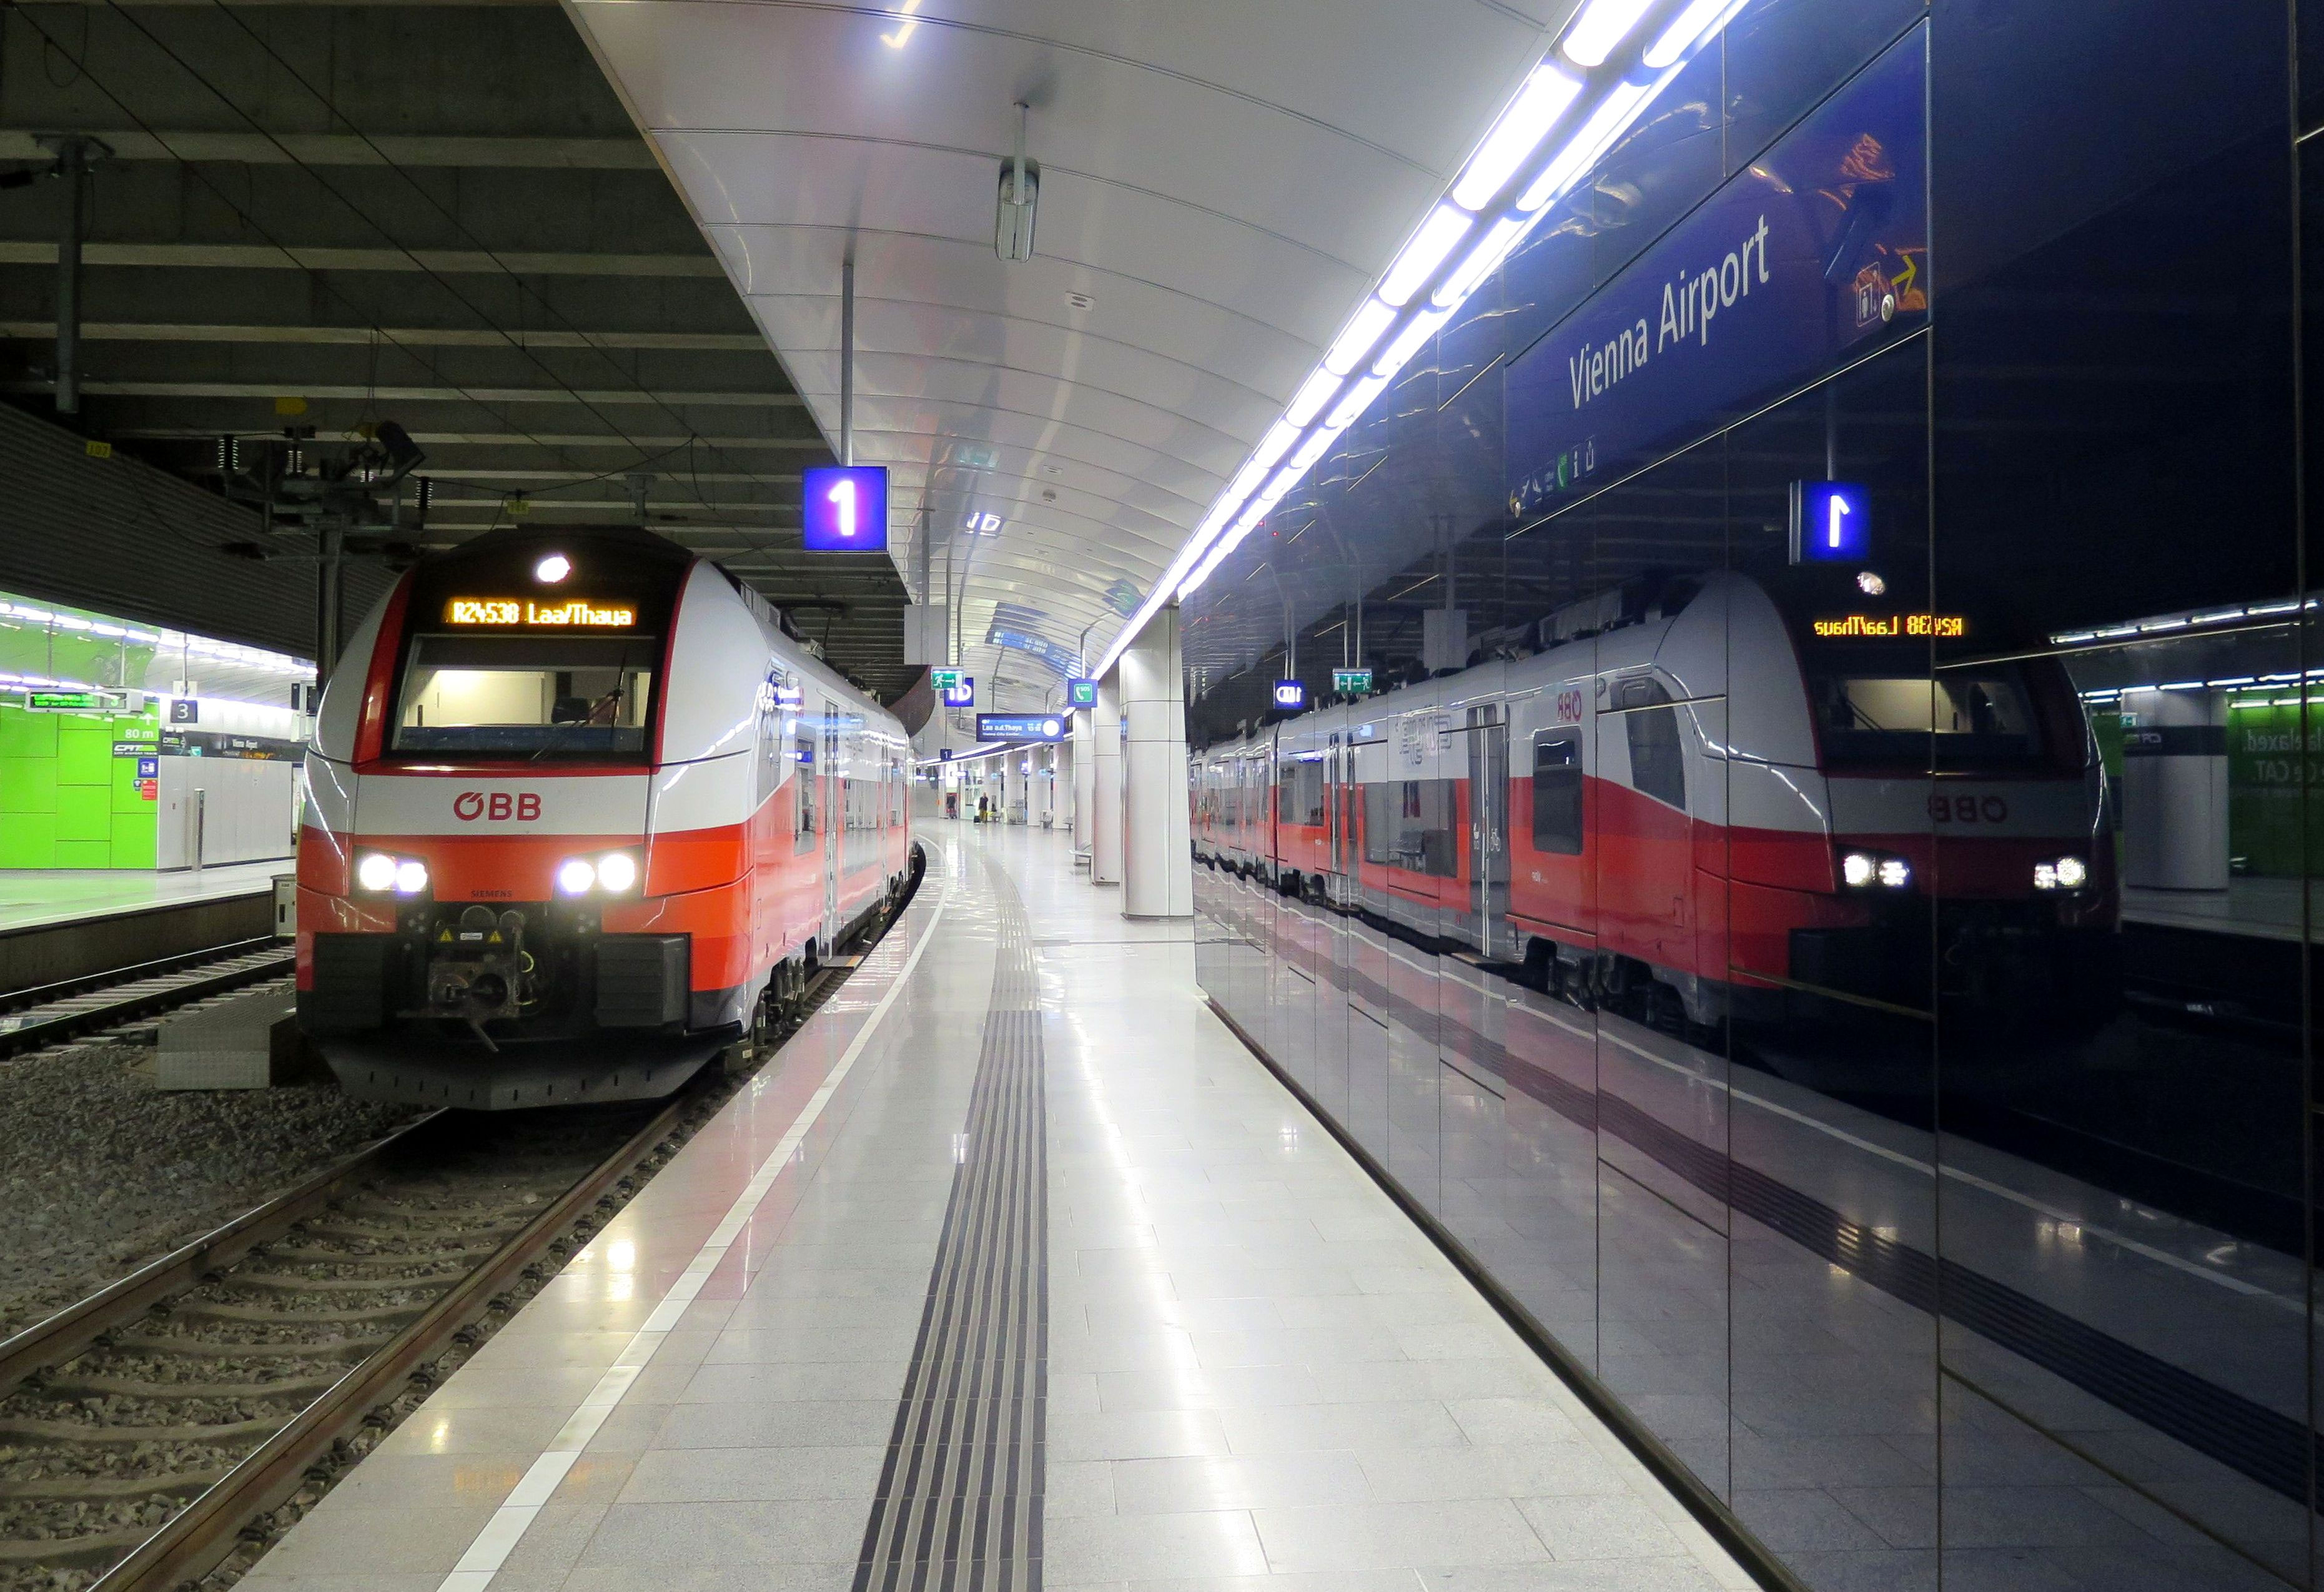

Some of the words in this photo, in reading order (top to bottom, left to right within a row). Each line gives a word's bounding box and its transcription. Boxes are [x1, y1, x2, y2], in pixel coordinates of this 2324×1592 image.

[1569, 318, 1648, 409] Vienna
[1658, 214, 1769, 354] Airport
[828, 480, 855, 536] 1
[453, 601, 520, 624] R24538
[528, 603, 632, 626] Laa/Thaya
[177, 703, 189, 719] 3
[125, 728, 140, 739] 80
[142, 730, 154, 739] m
[944, 751, 949, 759] 1
[453, 791, 541, 821] ÖBB
[470, 890, 512, 898] SIEMENS
